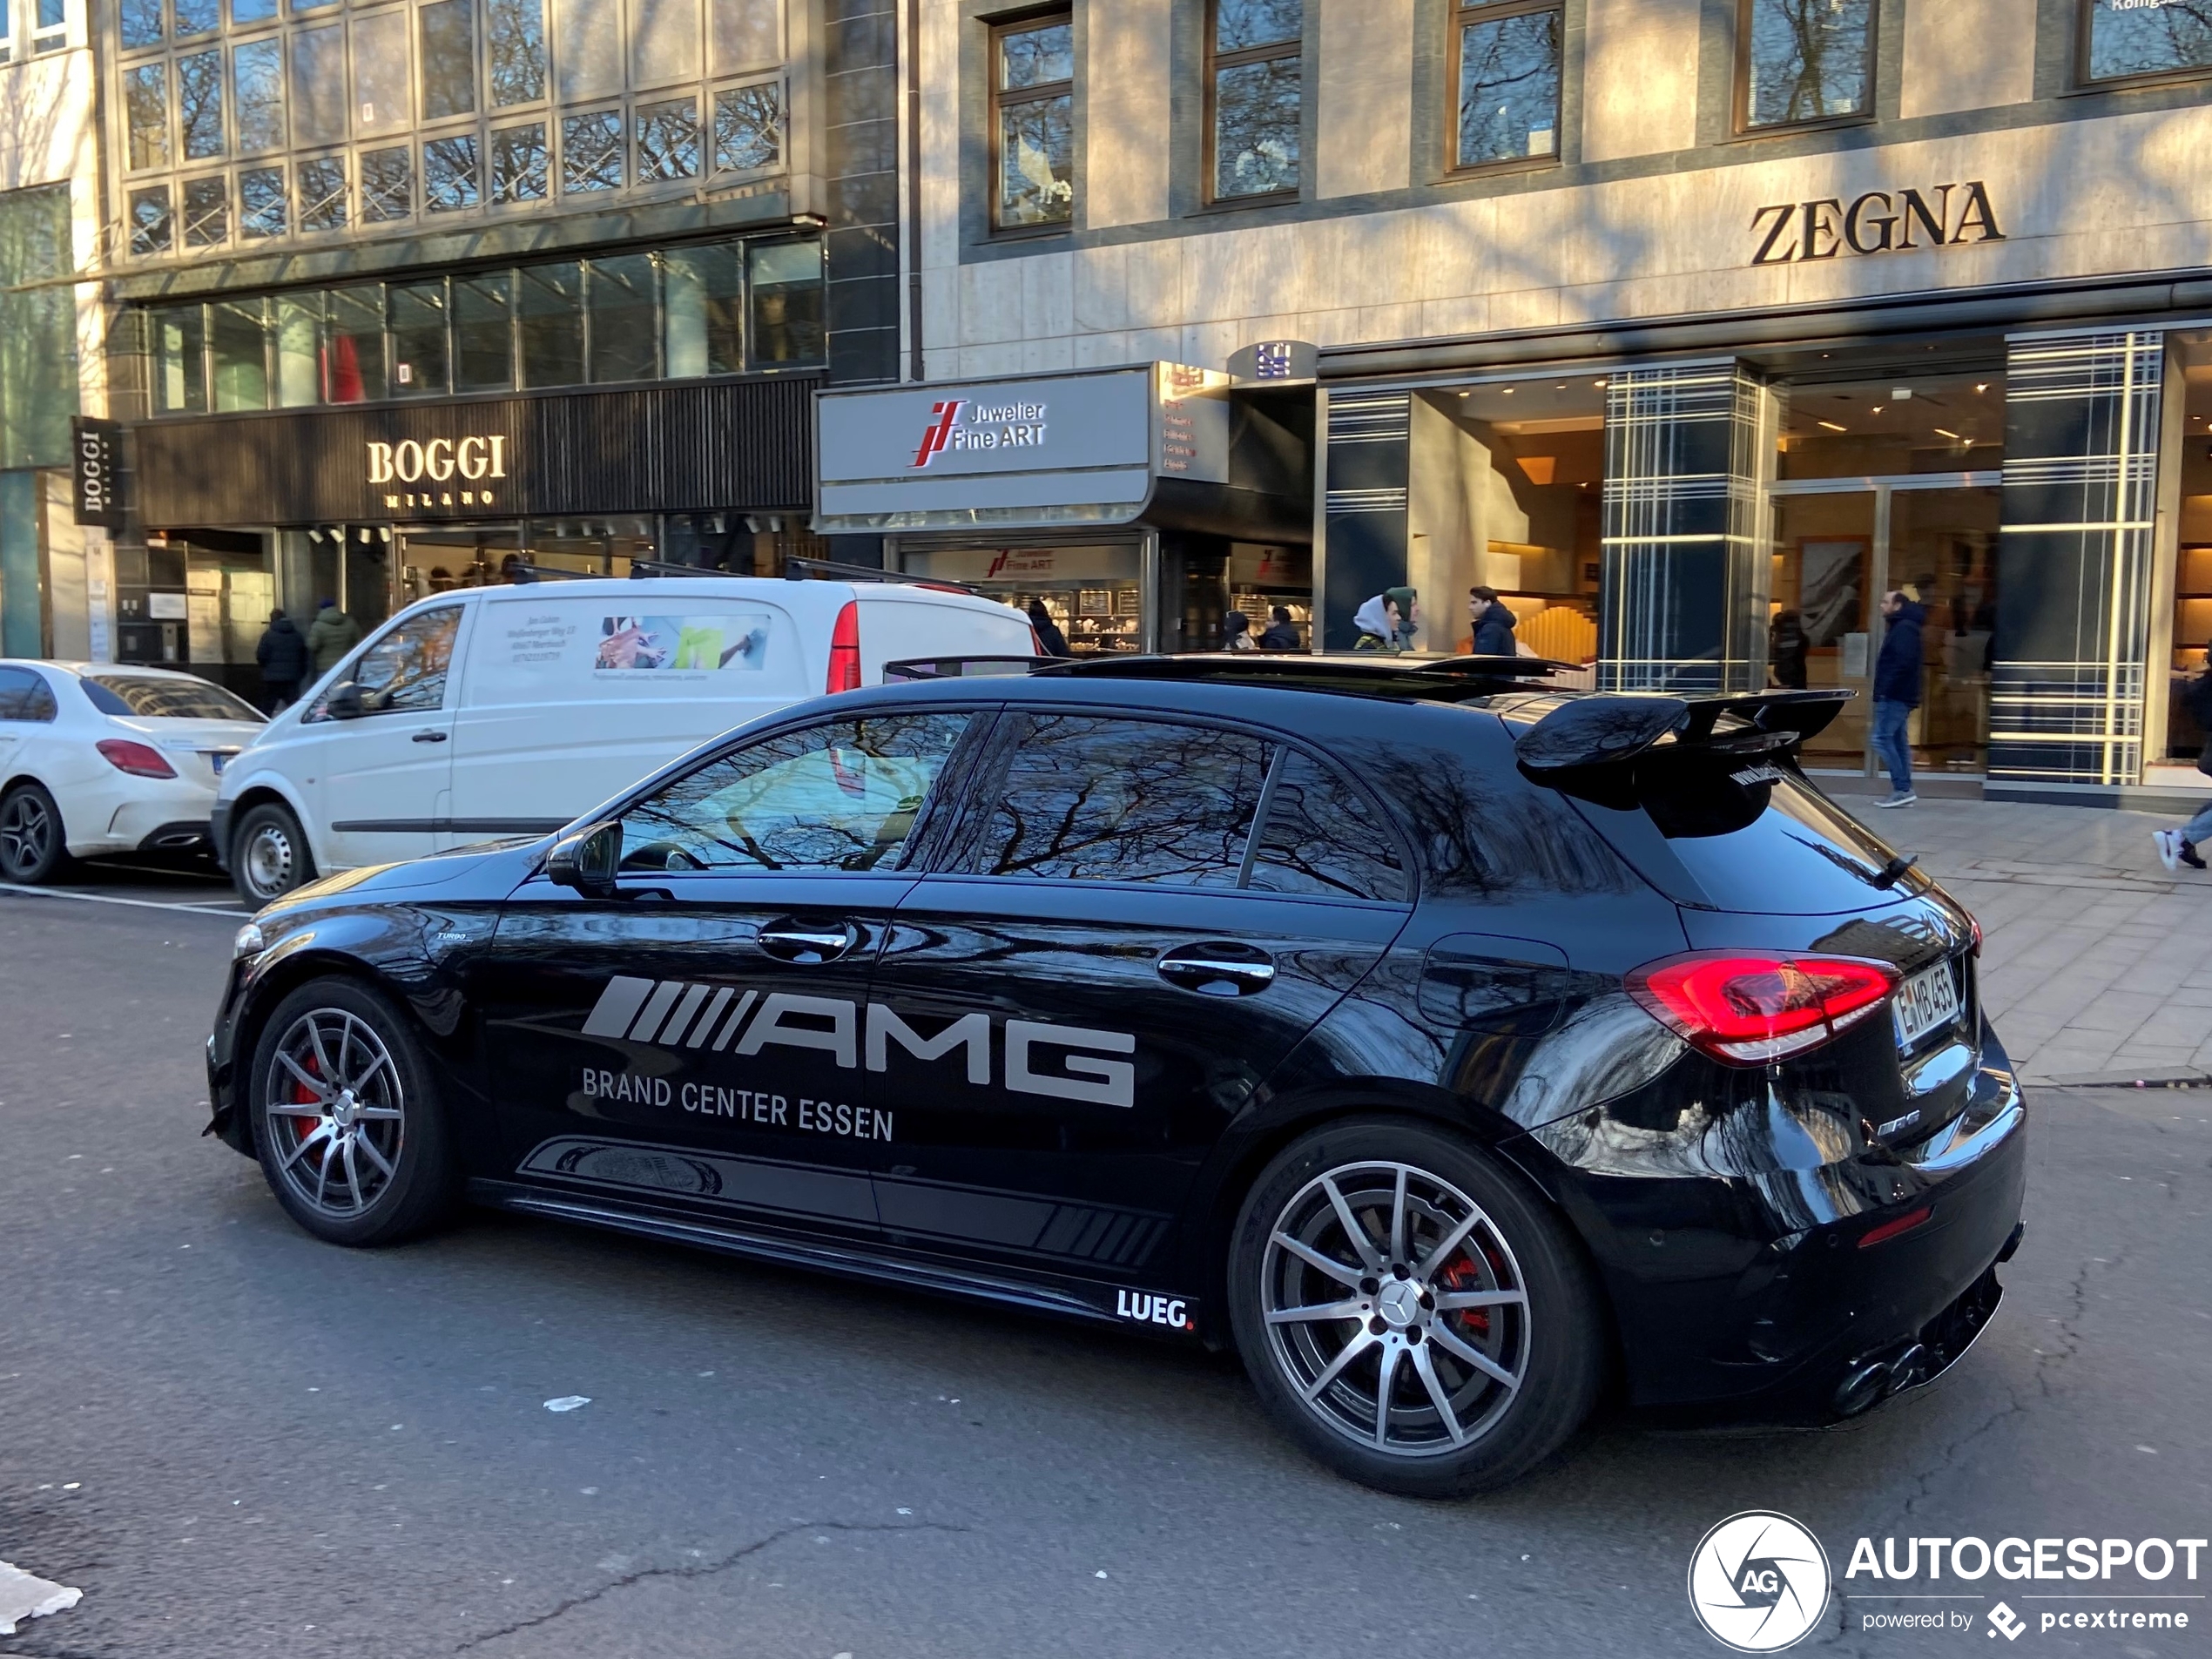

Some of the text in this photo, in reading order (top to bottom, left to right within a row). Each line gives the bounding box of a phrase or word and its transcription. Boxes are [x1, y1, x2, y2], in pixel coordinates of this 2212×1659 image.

[1750, 181, 2006, 265] ZEGNA
[970, 401, 1046, 423] Juwelier
[367, 435, 507, 483] BOGGI
[953, 424, 1047, 450] Fine ART
[81, 432, 103, 512] BOGGI
[384, 489, 494, 509] MILANO
[1030, 559, 1055, 570] ART
[736, 992, 1136, 1108] AMG
[583, 1068, 894, 1142] BRAND CENTER ESSEN
